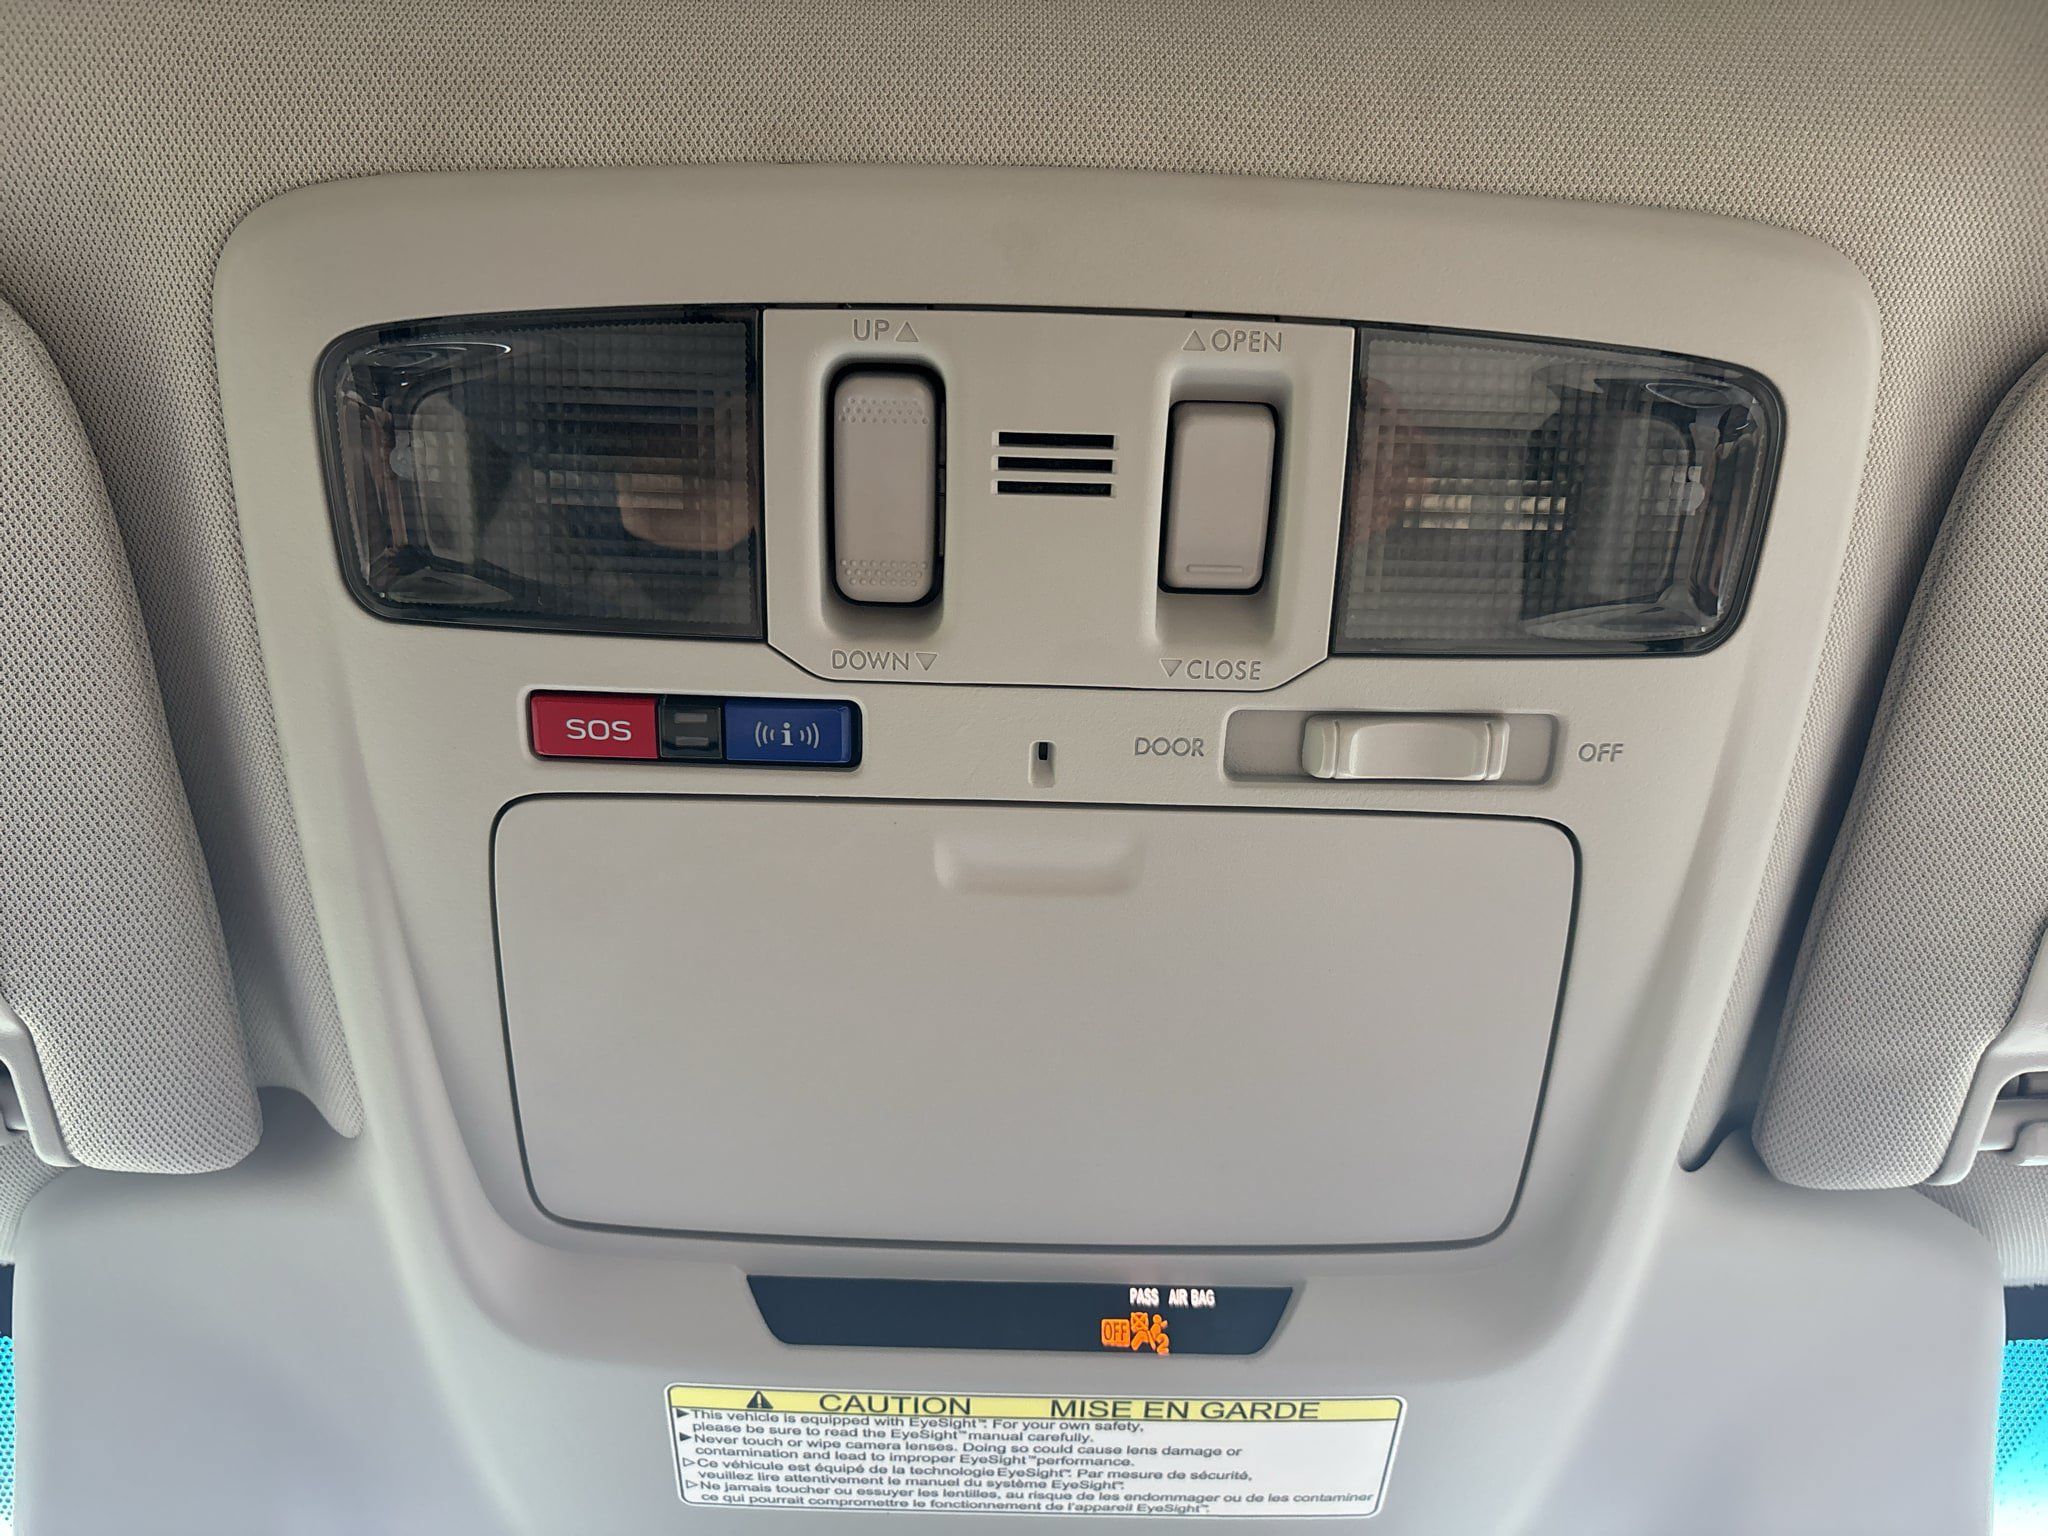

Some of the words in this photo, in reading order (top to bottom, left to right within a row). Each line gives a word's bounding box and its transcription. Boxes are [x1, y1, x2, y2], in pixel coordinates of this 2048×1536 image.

[853, 318, 890, 341] UP
[1211, 329, 1282, 352] OPEN
[831, 650, 909, 671] DOWN
[1186, 659, 1261, 680] CLOSE
[566, 718, 632, 741] SOS
[1134, 737, 1204, 757] DOOR
[1578, 743, 1624, 762] OFF
[1129, 1287, 1160, 1307] PASS
[1103, 1321, 1128, 1341] OFF
[819, 1394, 971, 1415] CAUTION
[1050, 1400, 1132, 1418] MISE
[1143, 1401, 1189, 1419] EN
[1200, 1401, 1320, 1420] GARDE
[691, 1409, 723, 1420] This
[727, 1411, 779, 1422] vehicle
[784, 1412, 796, 1423] is
[801, 1415, 870, 1427] equipped
[874, 1416, 904, 1426] with
[993, 1420, 1019, 1429] For
[1022, 1421, 1055, 1431] your
[1060, 1421, 1090, 1430] own
[692, 1423, 741, 1432] please
[746, 1424, 764, 1434] be
[769, 1426, 801, 1435] sure
[806, 1427, 820, 1436] to
[825, 1428, 858, 1437] read
[863, 1428, 886, 1438] the
[968, 1431, 1023, 1441] manual
[694, 1434, 738, 1443] Never
[743, 1436, 783, 1446] touch
[787, 1439, 803, 1447] or
[807, 1439, 841, 1449] wipe
[846, 1441, 901, 1450] camera
[963, 1442, 1006, 1454] Doing
[1011, 1445, 1029, 1453] so
[1033, 1444, 1073, 1454] could
[1077, 1446, 1122, 1455] cause
[1126, 1445, 1157, 1455] lens
[1162, 1446, 1222, 1458] damage
[1226, 1448, 1242, 1456] or
[695, 1447, 798, 1459] contamination
[803, 1451, 830, 1460] and
[835, 1451, 866, 1461] lead
[871, 1452, 885, 1461] to
[889, 1453, 955, 1464] improper
[697, 1458, 718, 1468] Ce
[722, 1459, 783, 1471] véhicule
[788, 1462, 810, 1471] est
[815, 1463, 864, 1474] équipé
[869, 1465, 888, 1474] de
[892, 1466, 905, 1475] la
[910, 1466, 995, 1478] technologie
[1077, 1468, 1104, 1478] Par
[1107, 1471, 1163, 1479] mesure
[1167, 1470, 1186, 1480] de
[698, 1471, 753, 1480] veuillez
[758, 1472, 780, 1481] lire
[785, 1473, 883, 1485] attentivement
[888, 1477, 901, 1485] le
[905, 1477, 959, 1486] manuel
[963, 1478, 982, 1487] du
[986, 1479, 1047, 1489] système
[700, 1481, 720, 1491] Ne
[725, 1482, 771, 1492] jamais
[776, 1484, 830, 1494] toucher
[834, 1487, 852, 1495] ou
[856, 1488, 914, 1498] essuyer
[918, 1488, 939, 1498] les
[1006, 1491, 1024, 1499] au
[1028, 1491, 1072, 1501] risque
[1076, 1491, 1095, 1501] de
[1099, 1492, 1119, 1501] les
[1124, 1492, 1220, 1503] endommager
[1224, 1494, 1242, 1503] ou
[1245, 1493, 1264, 1503] de
[1268, 1493, 1289, 1502] les
[1293, 1492, 1373, 1502] contaminer
[701, 1493, 719, 1501] ce
[723, 1493, 745, 1504] qui
[749, 1495, 804, 1504] pourrait
[808, 1498, 908, 1508] compromettre
[913, 1499, 926, 1508] le
[930, 1499, 1041, 1510] fonctionnement
[1045, 1502, 1064, 1510] de
